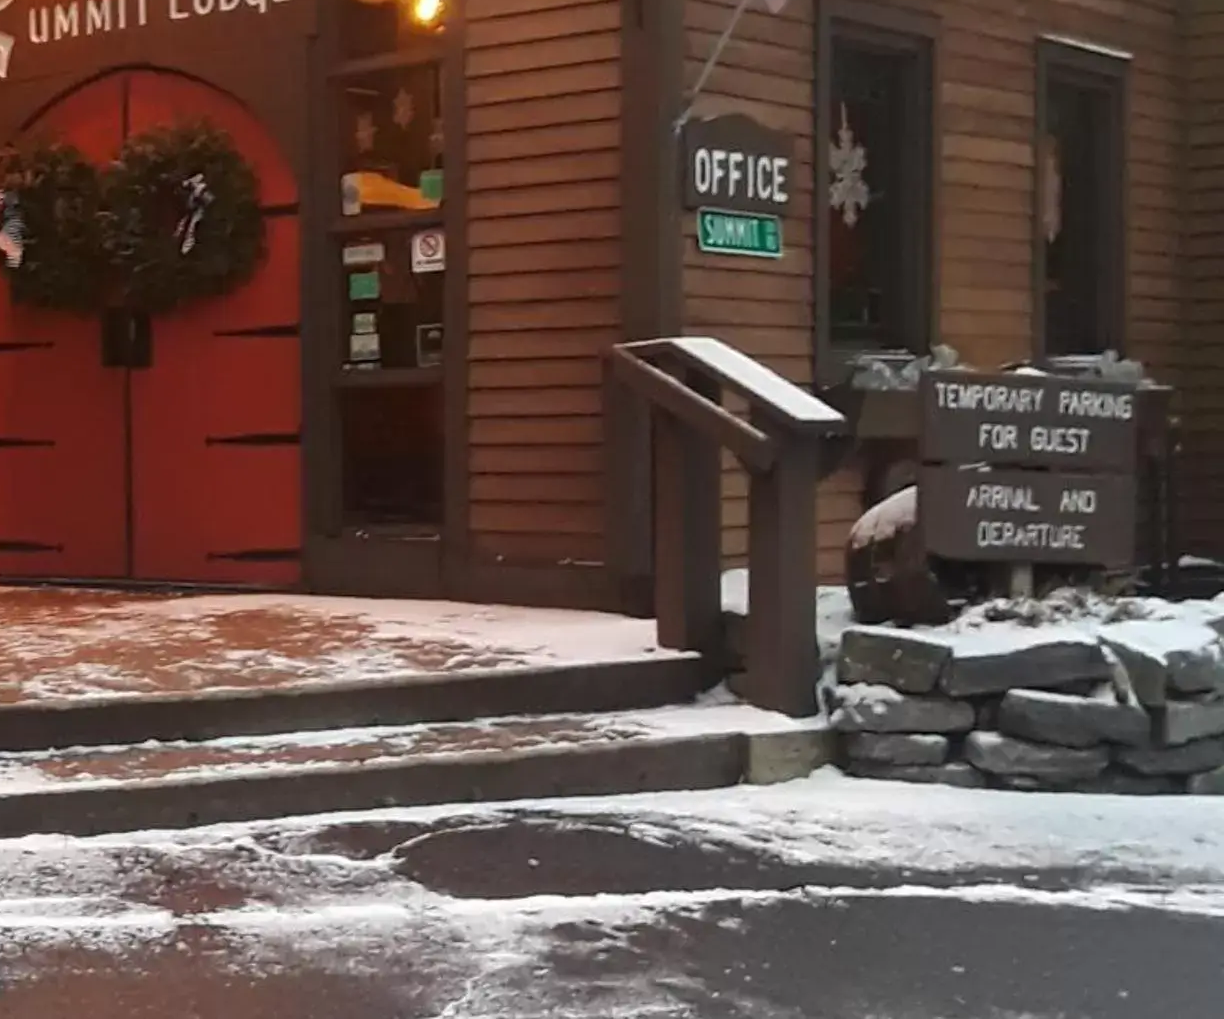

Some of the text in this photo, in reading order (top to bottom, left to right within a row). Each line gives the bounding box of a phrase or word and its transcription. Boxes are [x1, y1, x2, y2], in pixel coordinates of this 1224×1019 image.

[694, 148, 789, 203] OFFICE
[704, 214, 760, 248] SUMMIT
[934, 382, 1133, 419] TEMPORARY PARKING
[979, 424, 1091, 453] FOR GUEST
[966, 485, 1096, 513] ARRIVAL AND
[977, 521, 1085, 548] DEPARTURE
